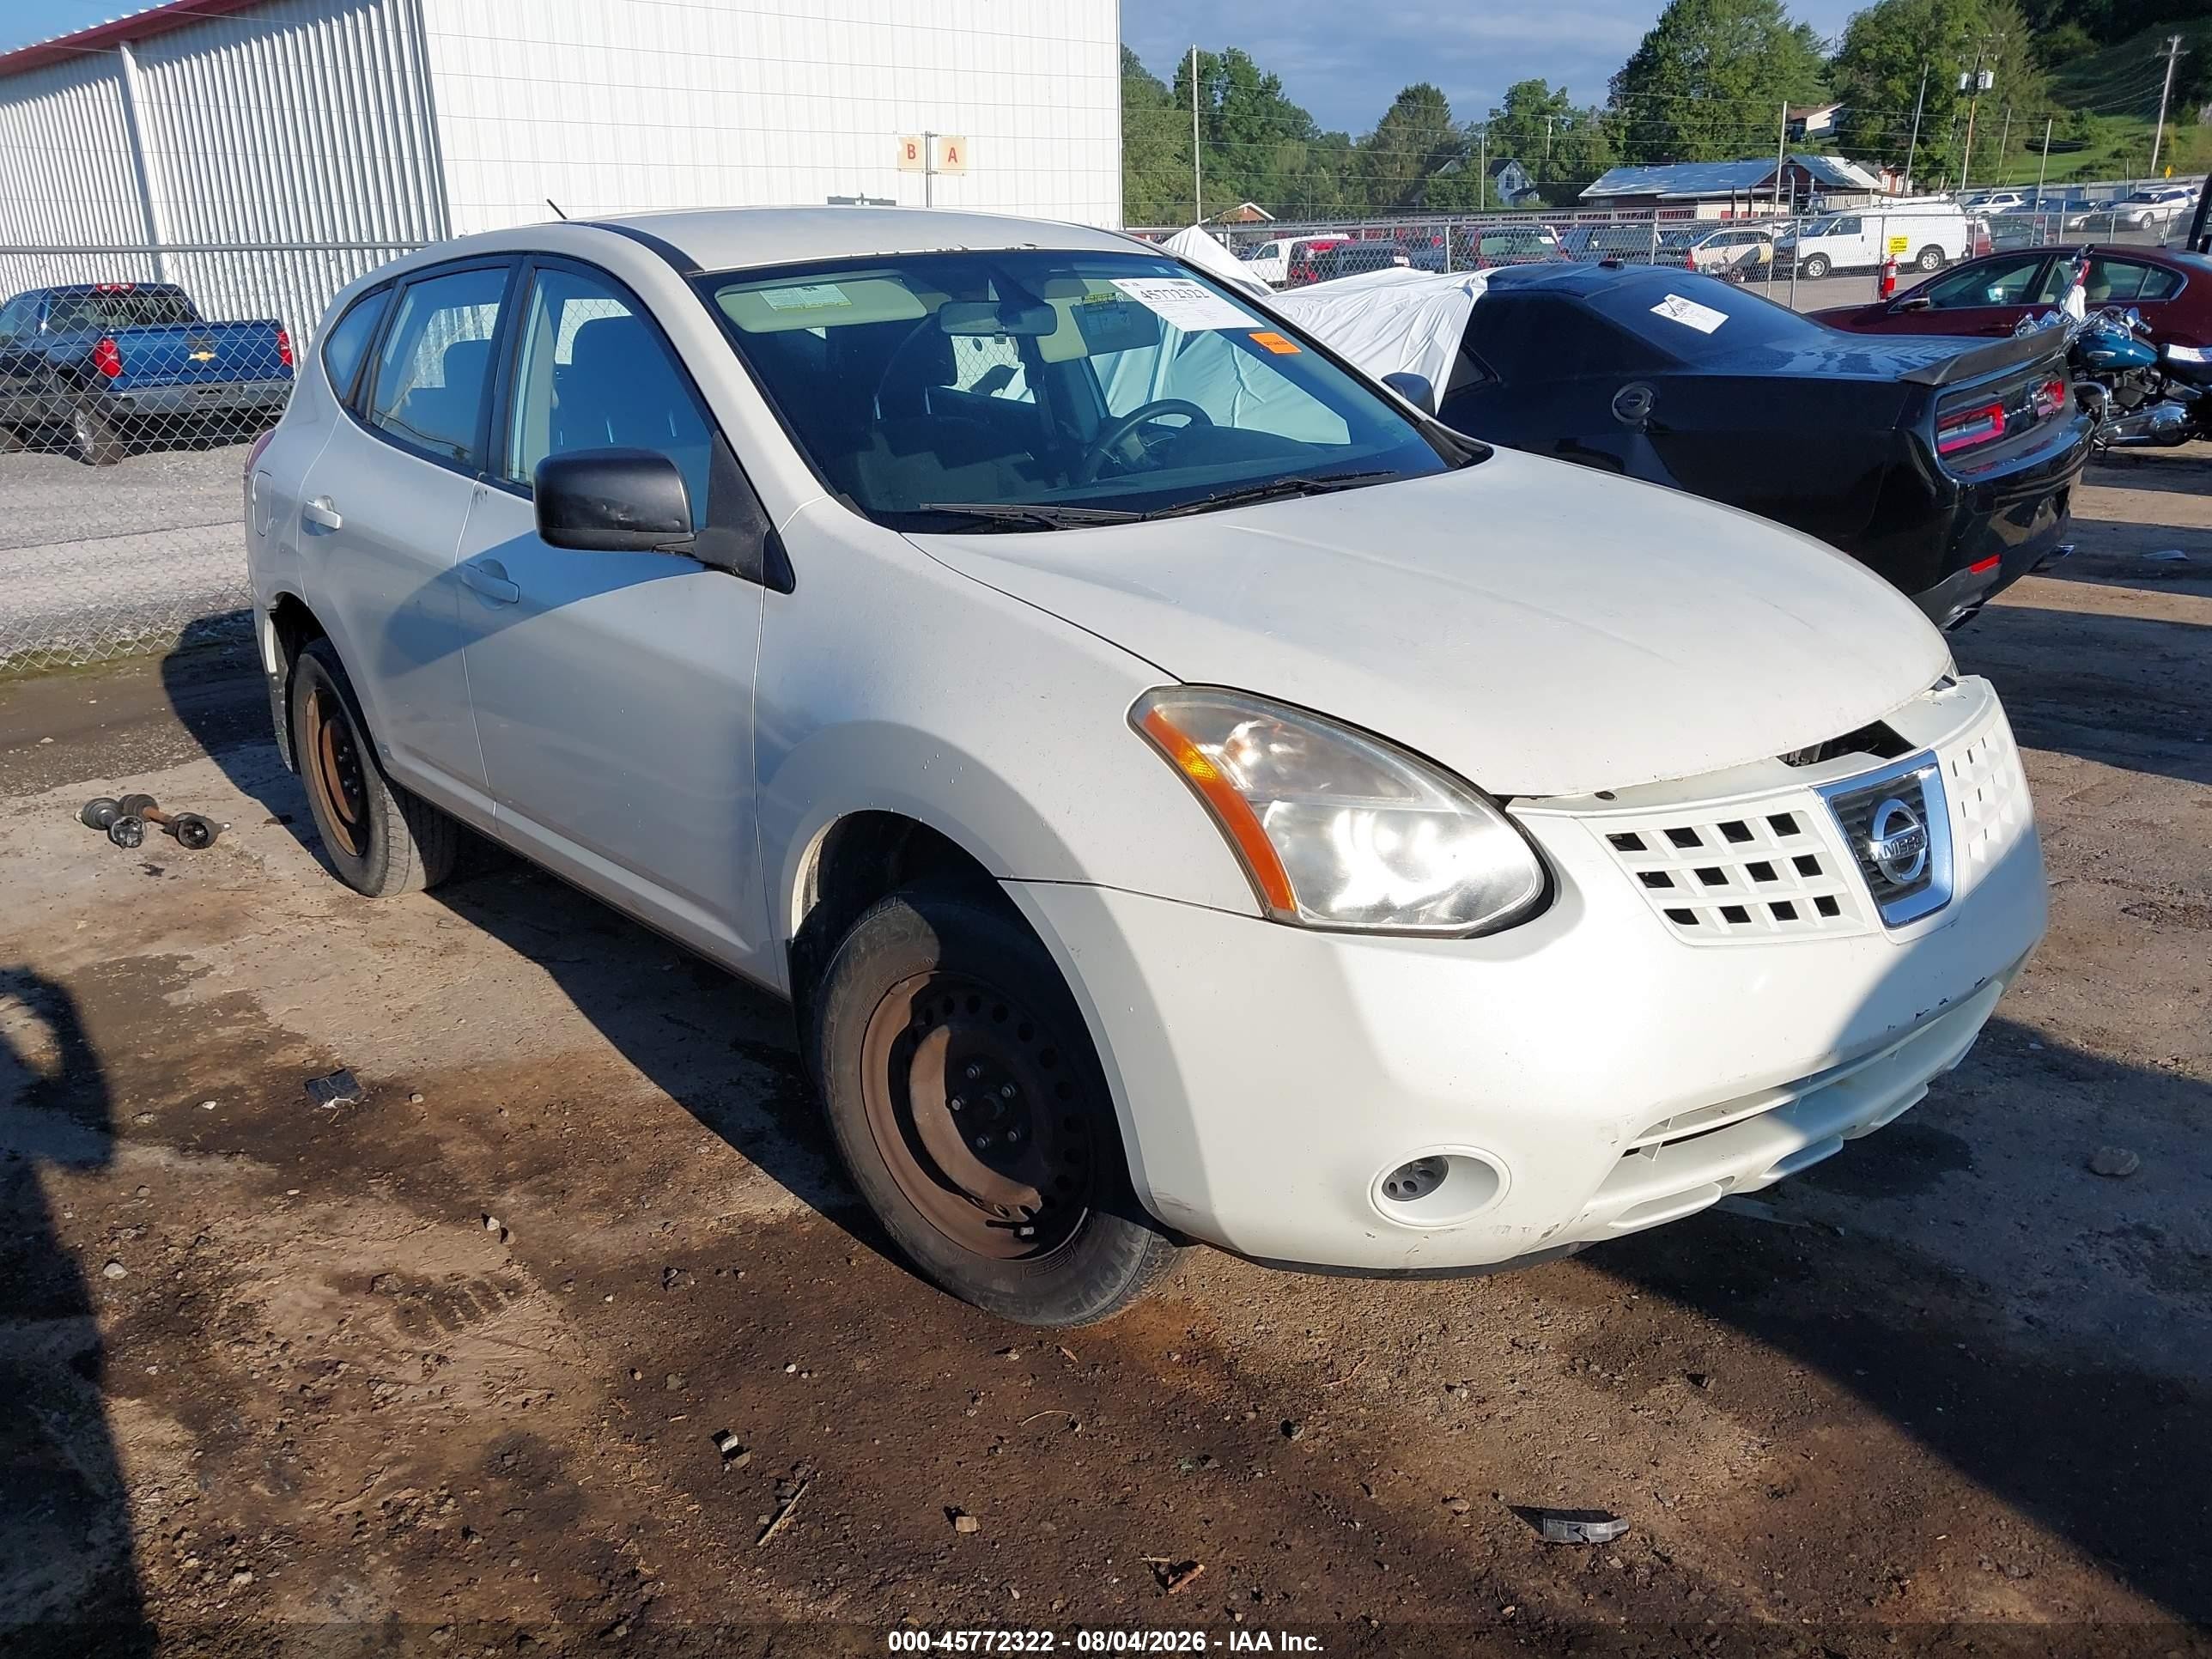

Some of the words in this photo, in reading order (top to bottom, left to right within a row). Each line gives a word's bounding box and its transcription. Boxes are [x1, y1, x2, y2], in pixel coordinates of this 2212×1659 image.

[907, 144, 916, 160] B
[948, 147, 958, 163] A
[1139, 289, 1210, 301] 45772322
